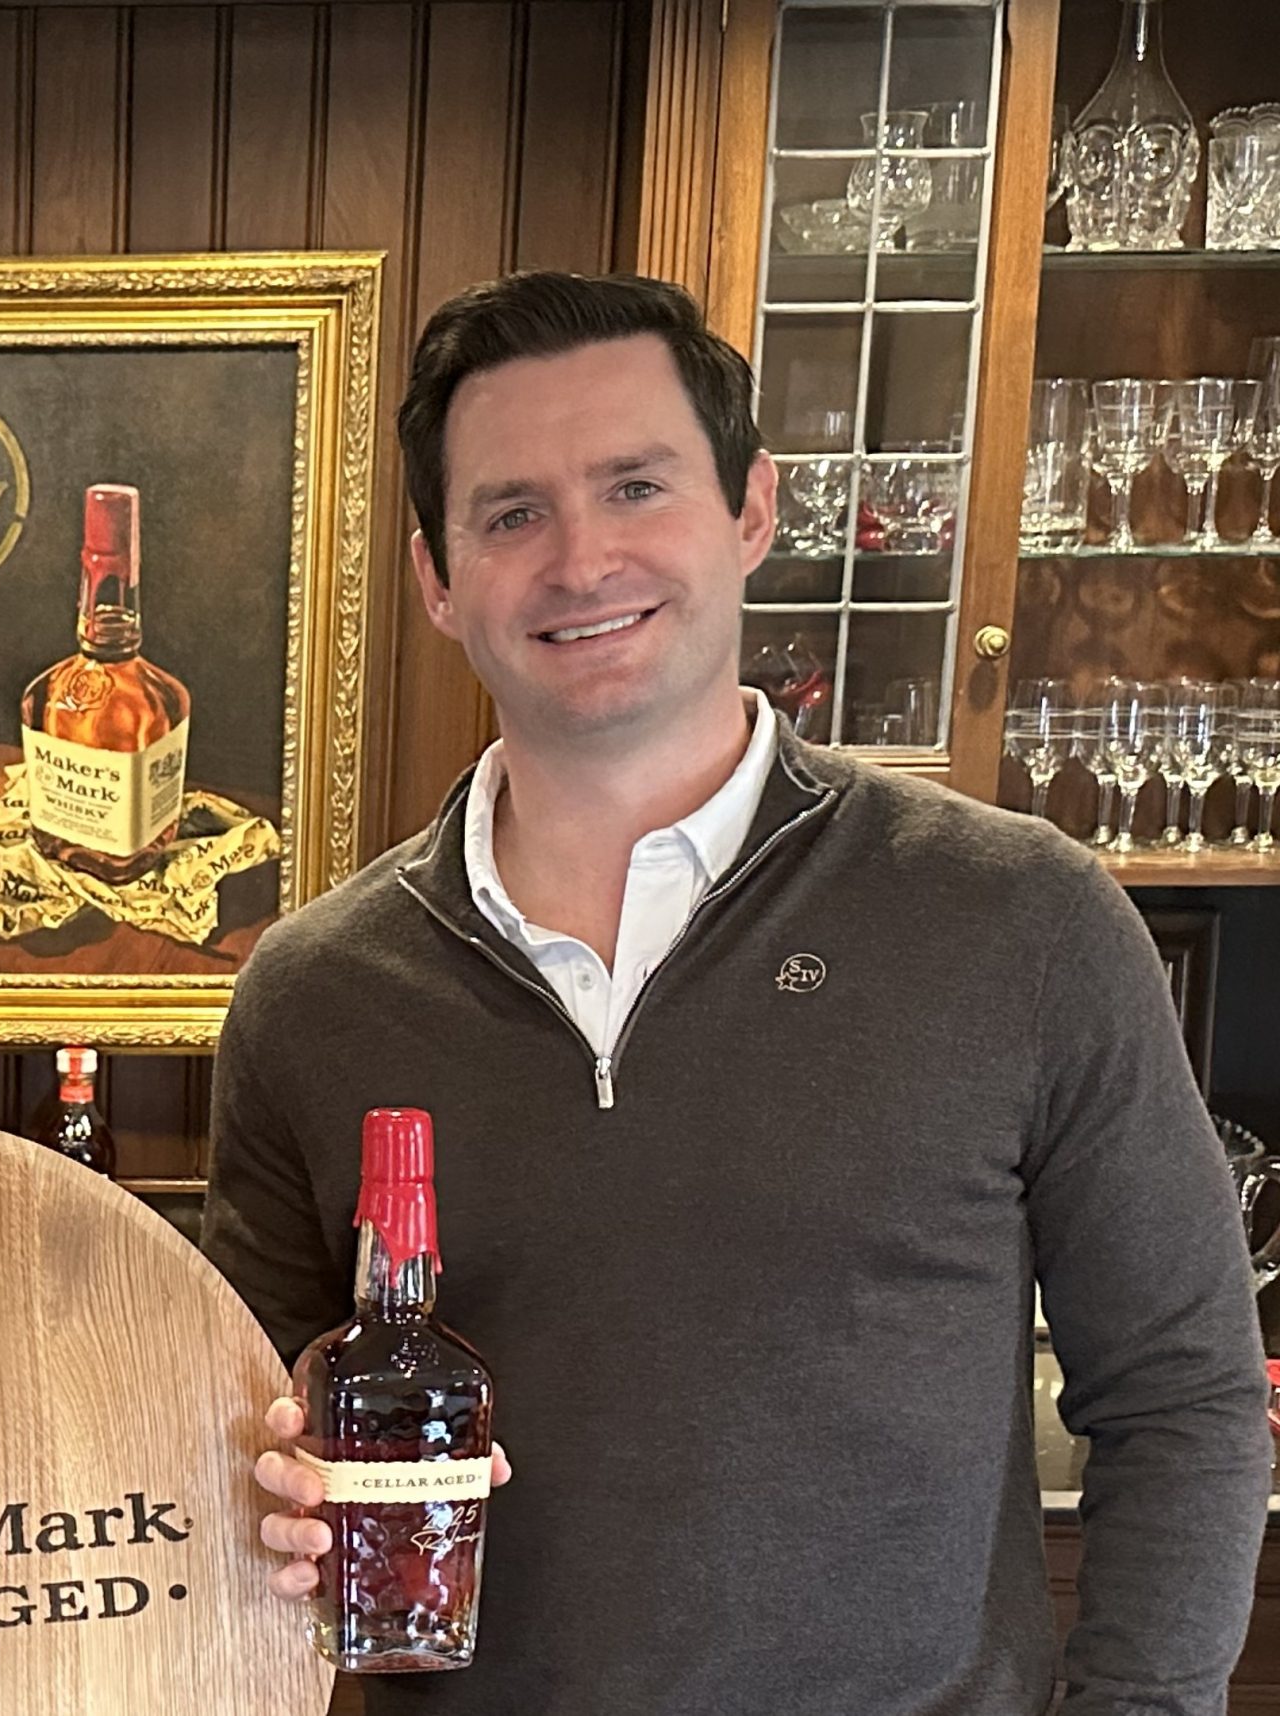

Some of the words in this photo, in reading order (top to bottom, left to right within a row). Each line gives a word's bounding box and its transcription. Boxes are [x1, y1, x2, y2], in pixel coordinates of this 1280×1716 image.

[35, 745, 120, 782] Maker's
[57, 775, 120, 803] Mark
[45, 794, 109, 819] WHISKY
[362, 1477, 429, 1489] CELLAR
[433, 1473, 476, 1487] AGED
